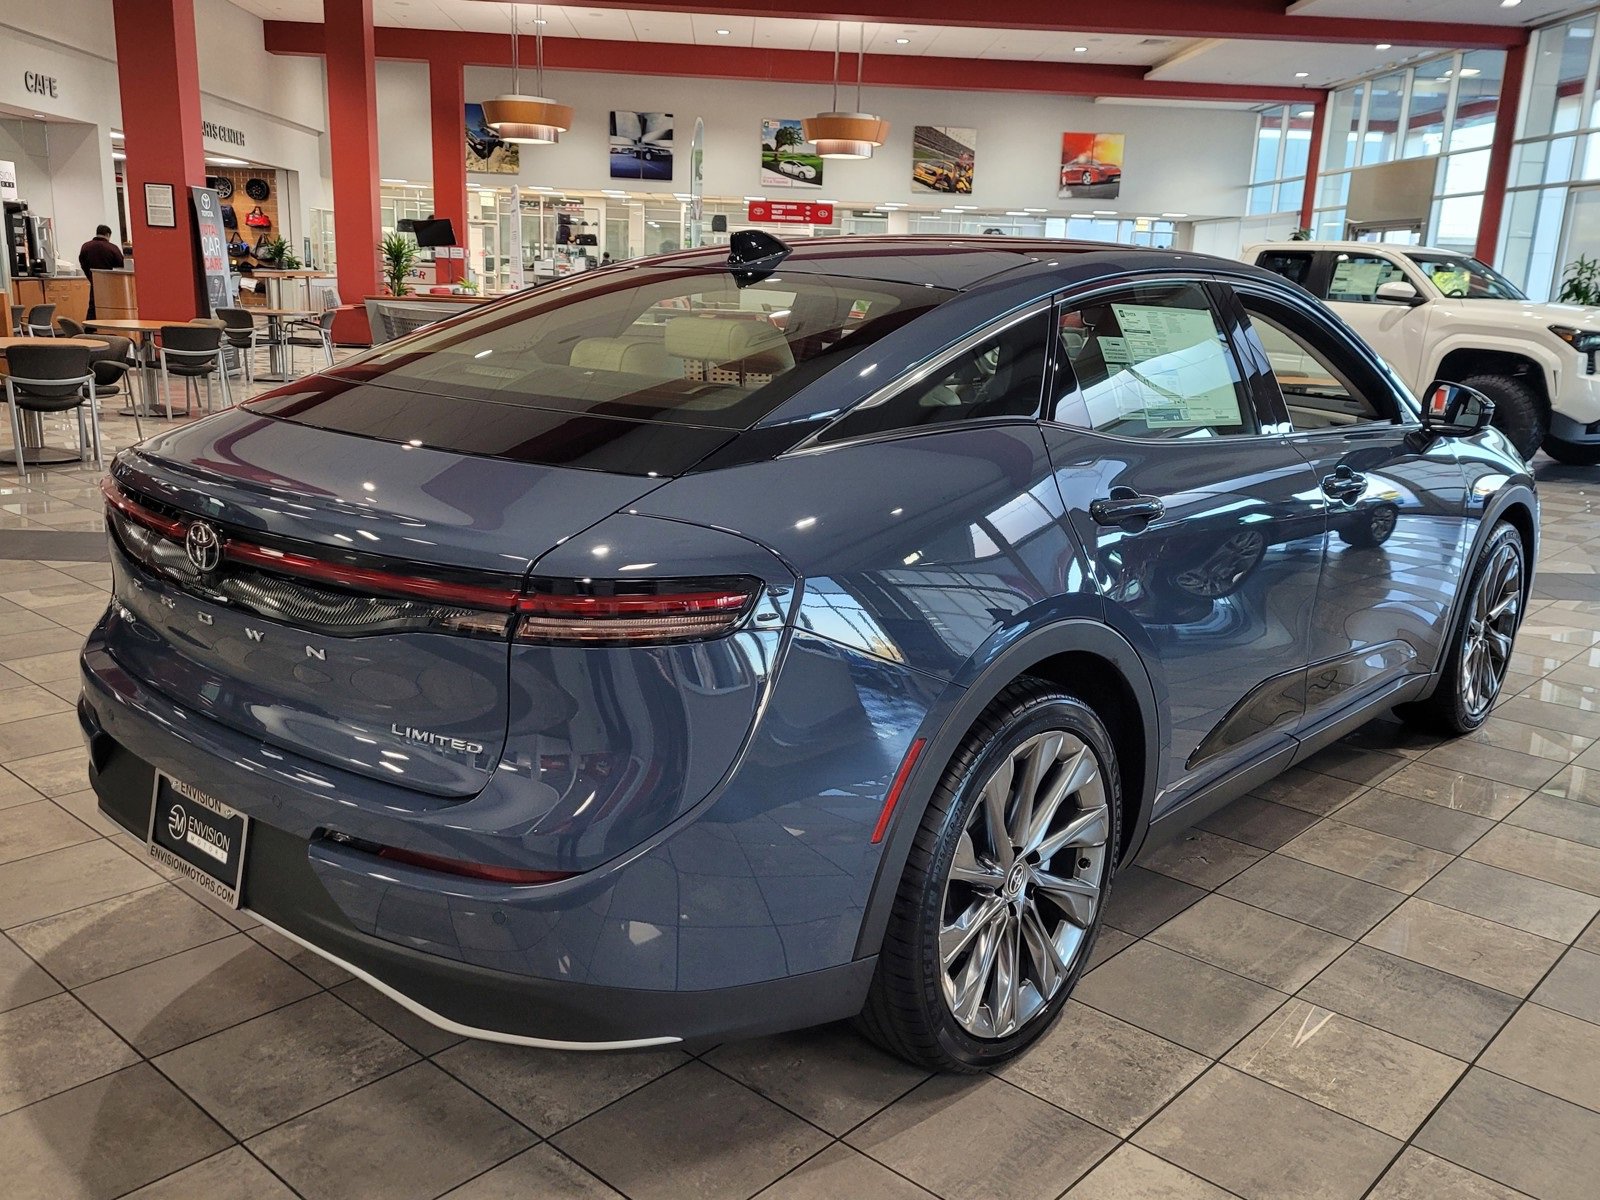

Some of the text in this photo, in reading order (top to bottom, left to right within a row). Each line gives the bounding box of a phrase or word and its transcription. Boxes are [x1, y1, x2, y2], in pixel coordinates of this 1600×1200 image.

[24, 70, 58, 99] CAFE
[201, 120, 246, 147] ARTS CENTER
[202, 236, 221, 256] CAR
[205, 257, 223, 271] CARE
[391, 722, 484, 755] LIMITED
[180, 782, 221, 814] ENVISION
[188, 815, 231, 852] ENVISION
[150, 845, 236, 905] ENVISIONMOTORS.COM
